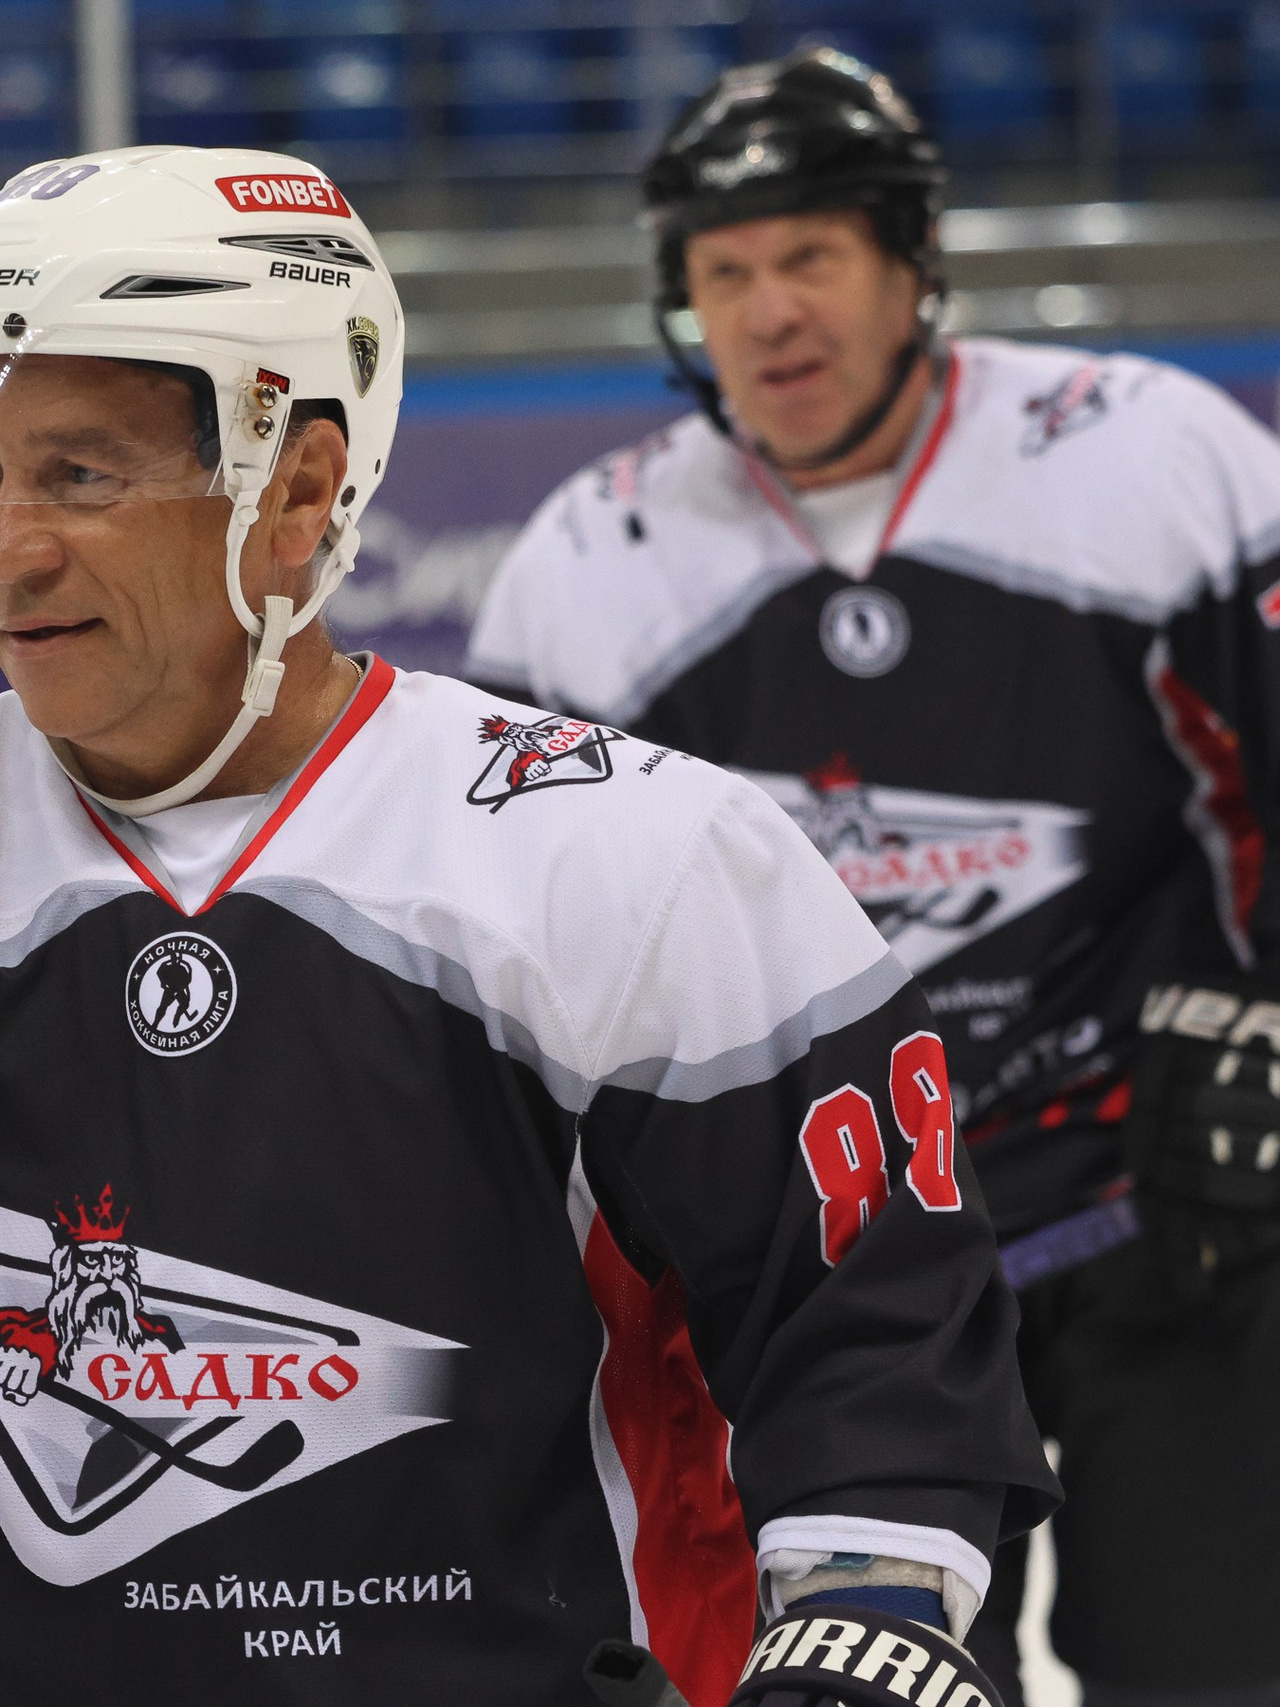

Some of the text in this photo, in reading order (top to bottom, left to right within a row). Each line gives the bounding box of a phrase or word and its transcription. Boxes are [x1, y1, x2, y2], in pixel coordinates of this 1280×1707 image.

[231, 179, 338, 209] FONBET
[144, 941, 211, 965] НОЧНАЯ
[202, 990, 229, 1033] ЛИГА
[86, 1352, 360, 1411] САДКО
[124, 1567, 472, 1612] ЗАБАЙКАЛЬСКИЙ
[243, 1621, 342, 1658] КРАЙ
